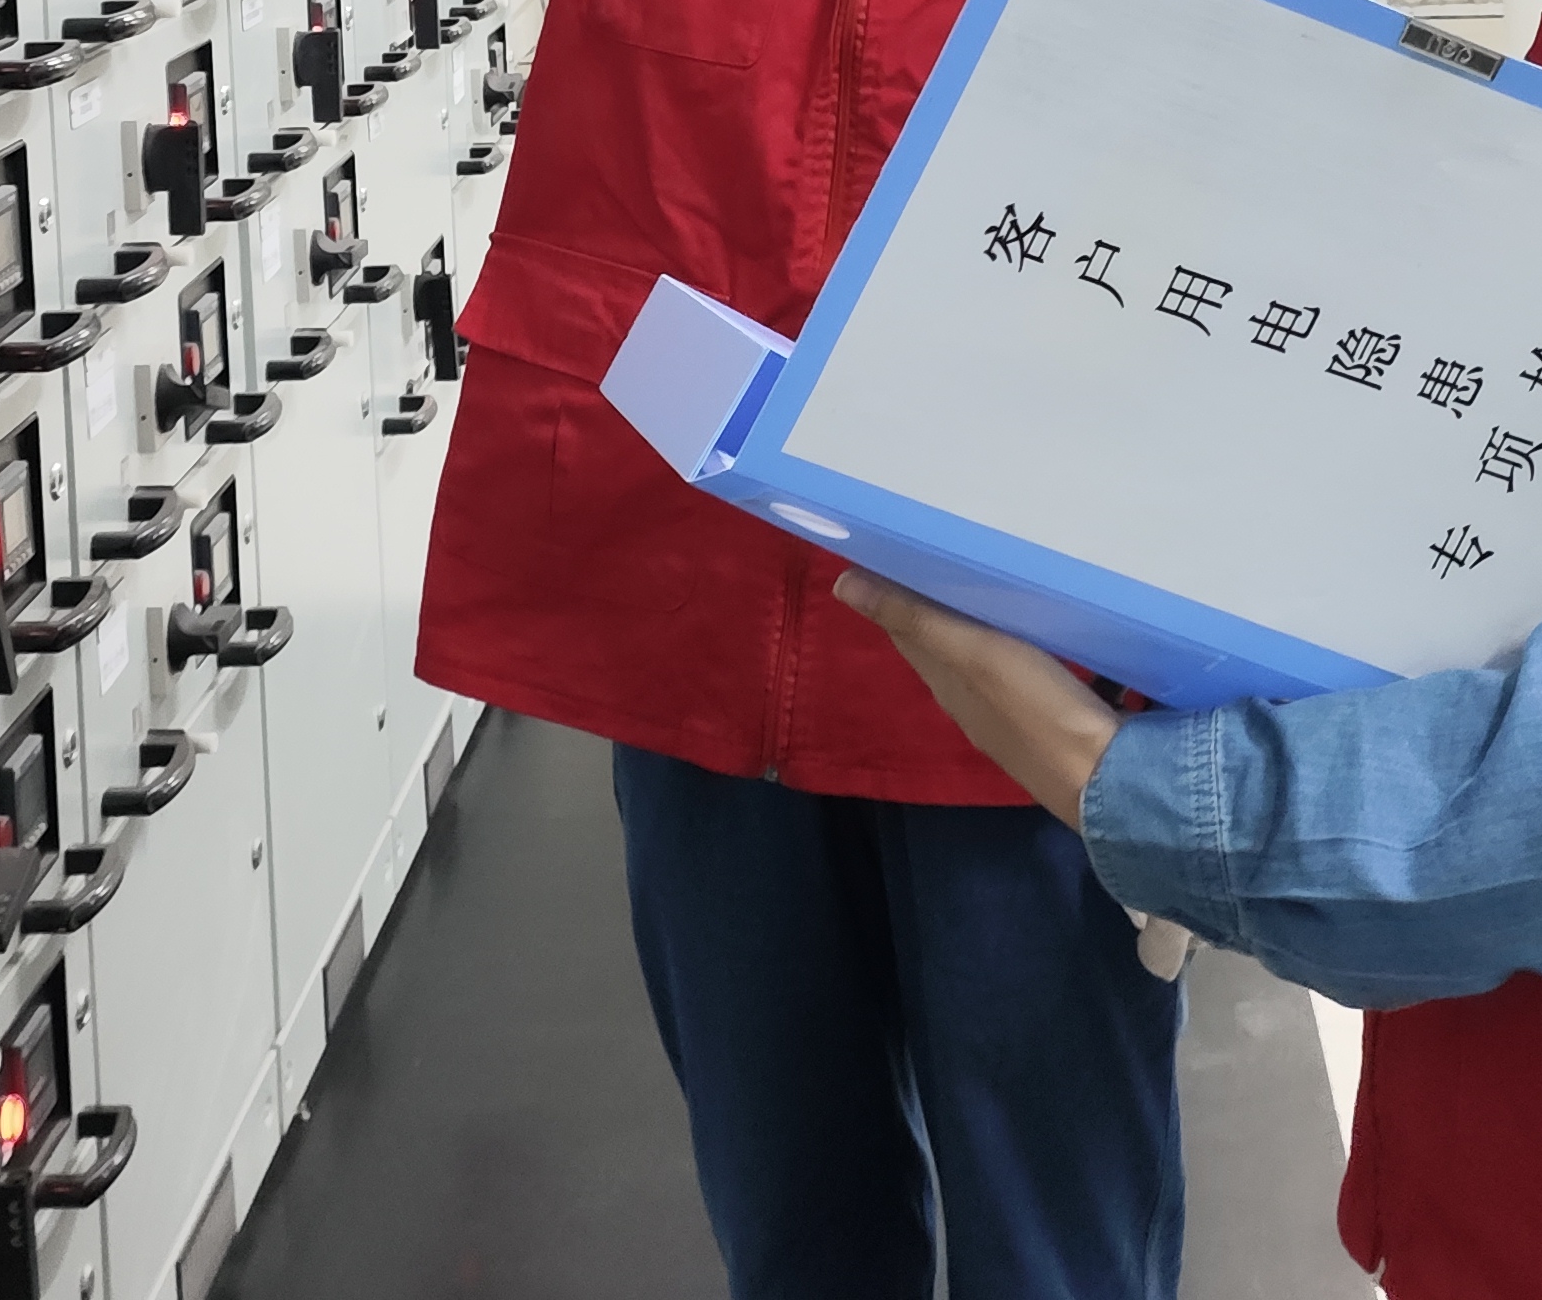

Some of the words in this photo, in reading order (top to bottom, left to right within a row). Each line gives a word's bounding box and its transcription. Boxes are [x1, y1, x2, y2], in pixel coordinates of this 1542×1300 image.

[983, 203, 1484, 419] 客户用电隐患
